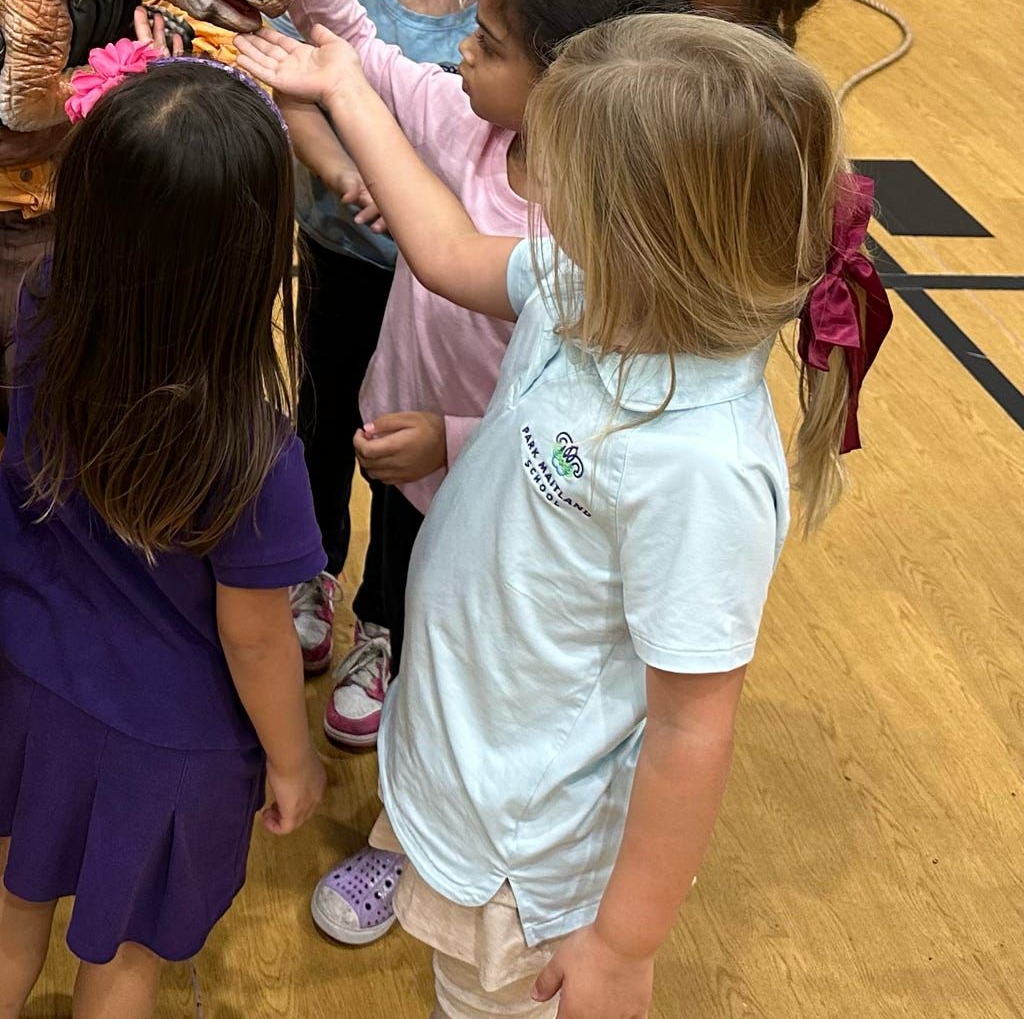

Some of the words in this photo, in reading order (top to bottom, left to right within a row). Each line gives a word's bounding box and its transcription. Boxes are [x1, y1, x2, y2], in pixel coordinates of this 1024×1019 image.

[522, 426, 539, 458] PARK
[538, 461, 592, 517] MAITLAND
[524, 459, 560, 507] SCHOOL
